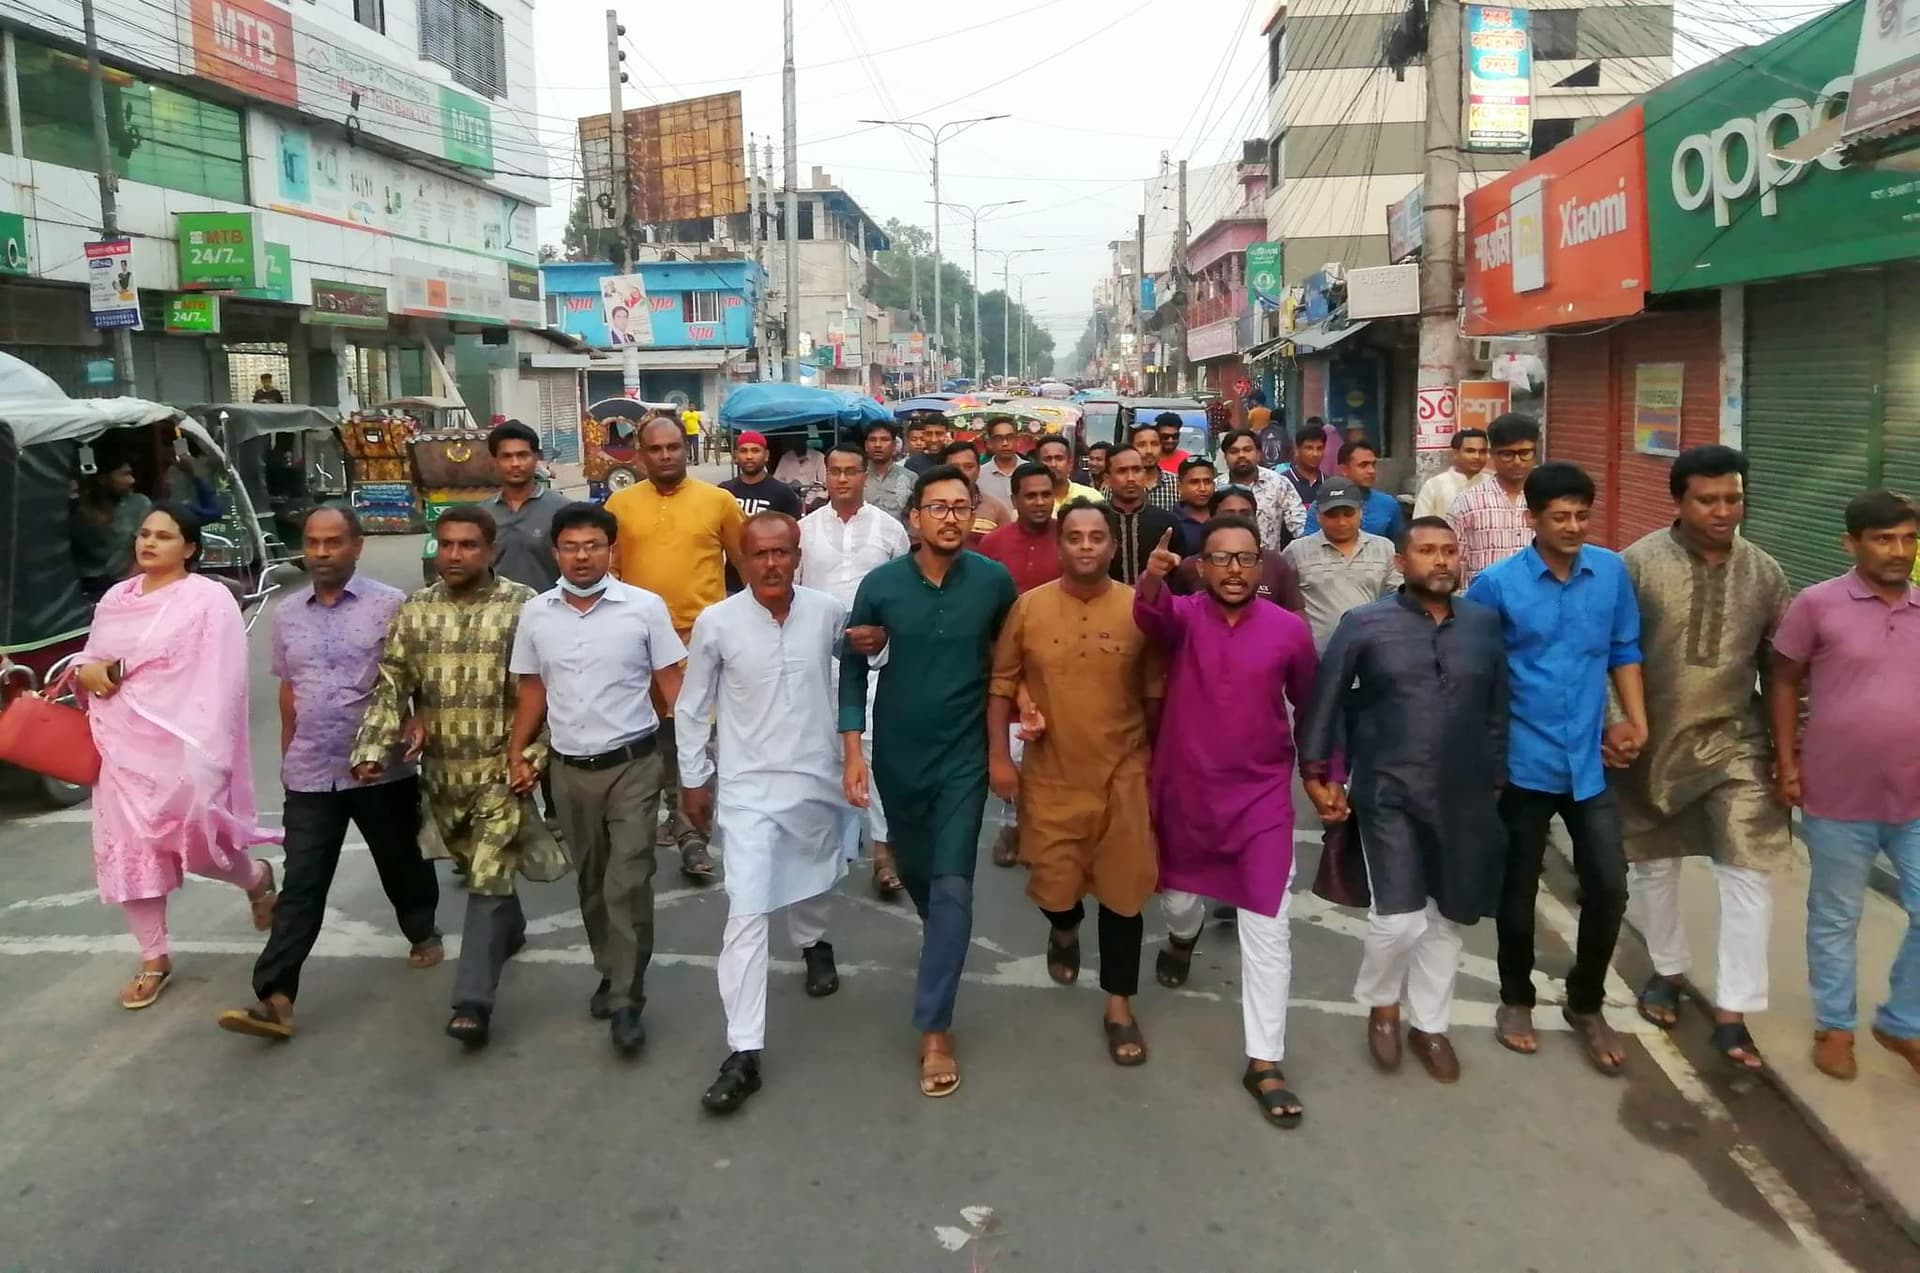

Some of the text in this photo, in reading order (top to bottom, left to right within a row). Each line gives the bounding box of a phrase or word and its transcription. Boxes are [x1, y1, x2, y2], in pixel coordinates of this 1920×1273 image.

[212, 2, 276, 65] MTB
[451, 108, 489, 149] MTB
[1560, 176, 1627, 249] Xiaomi
[204, 229, 243, 245] MTB
[191, 247, 235, 265] 24/7
[173, 312, 202, 322] 24/7
[688, 326, 714, 341] Spa
